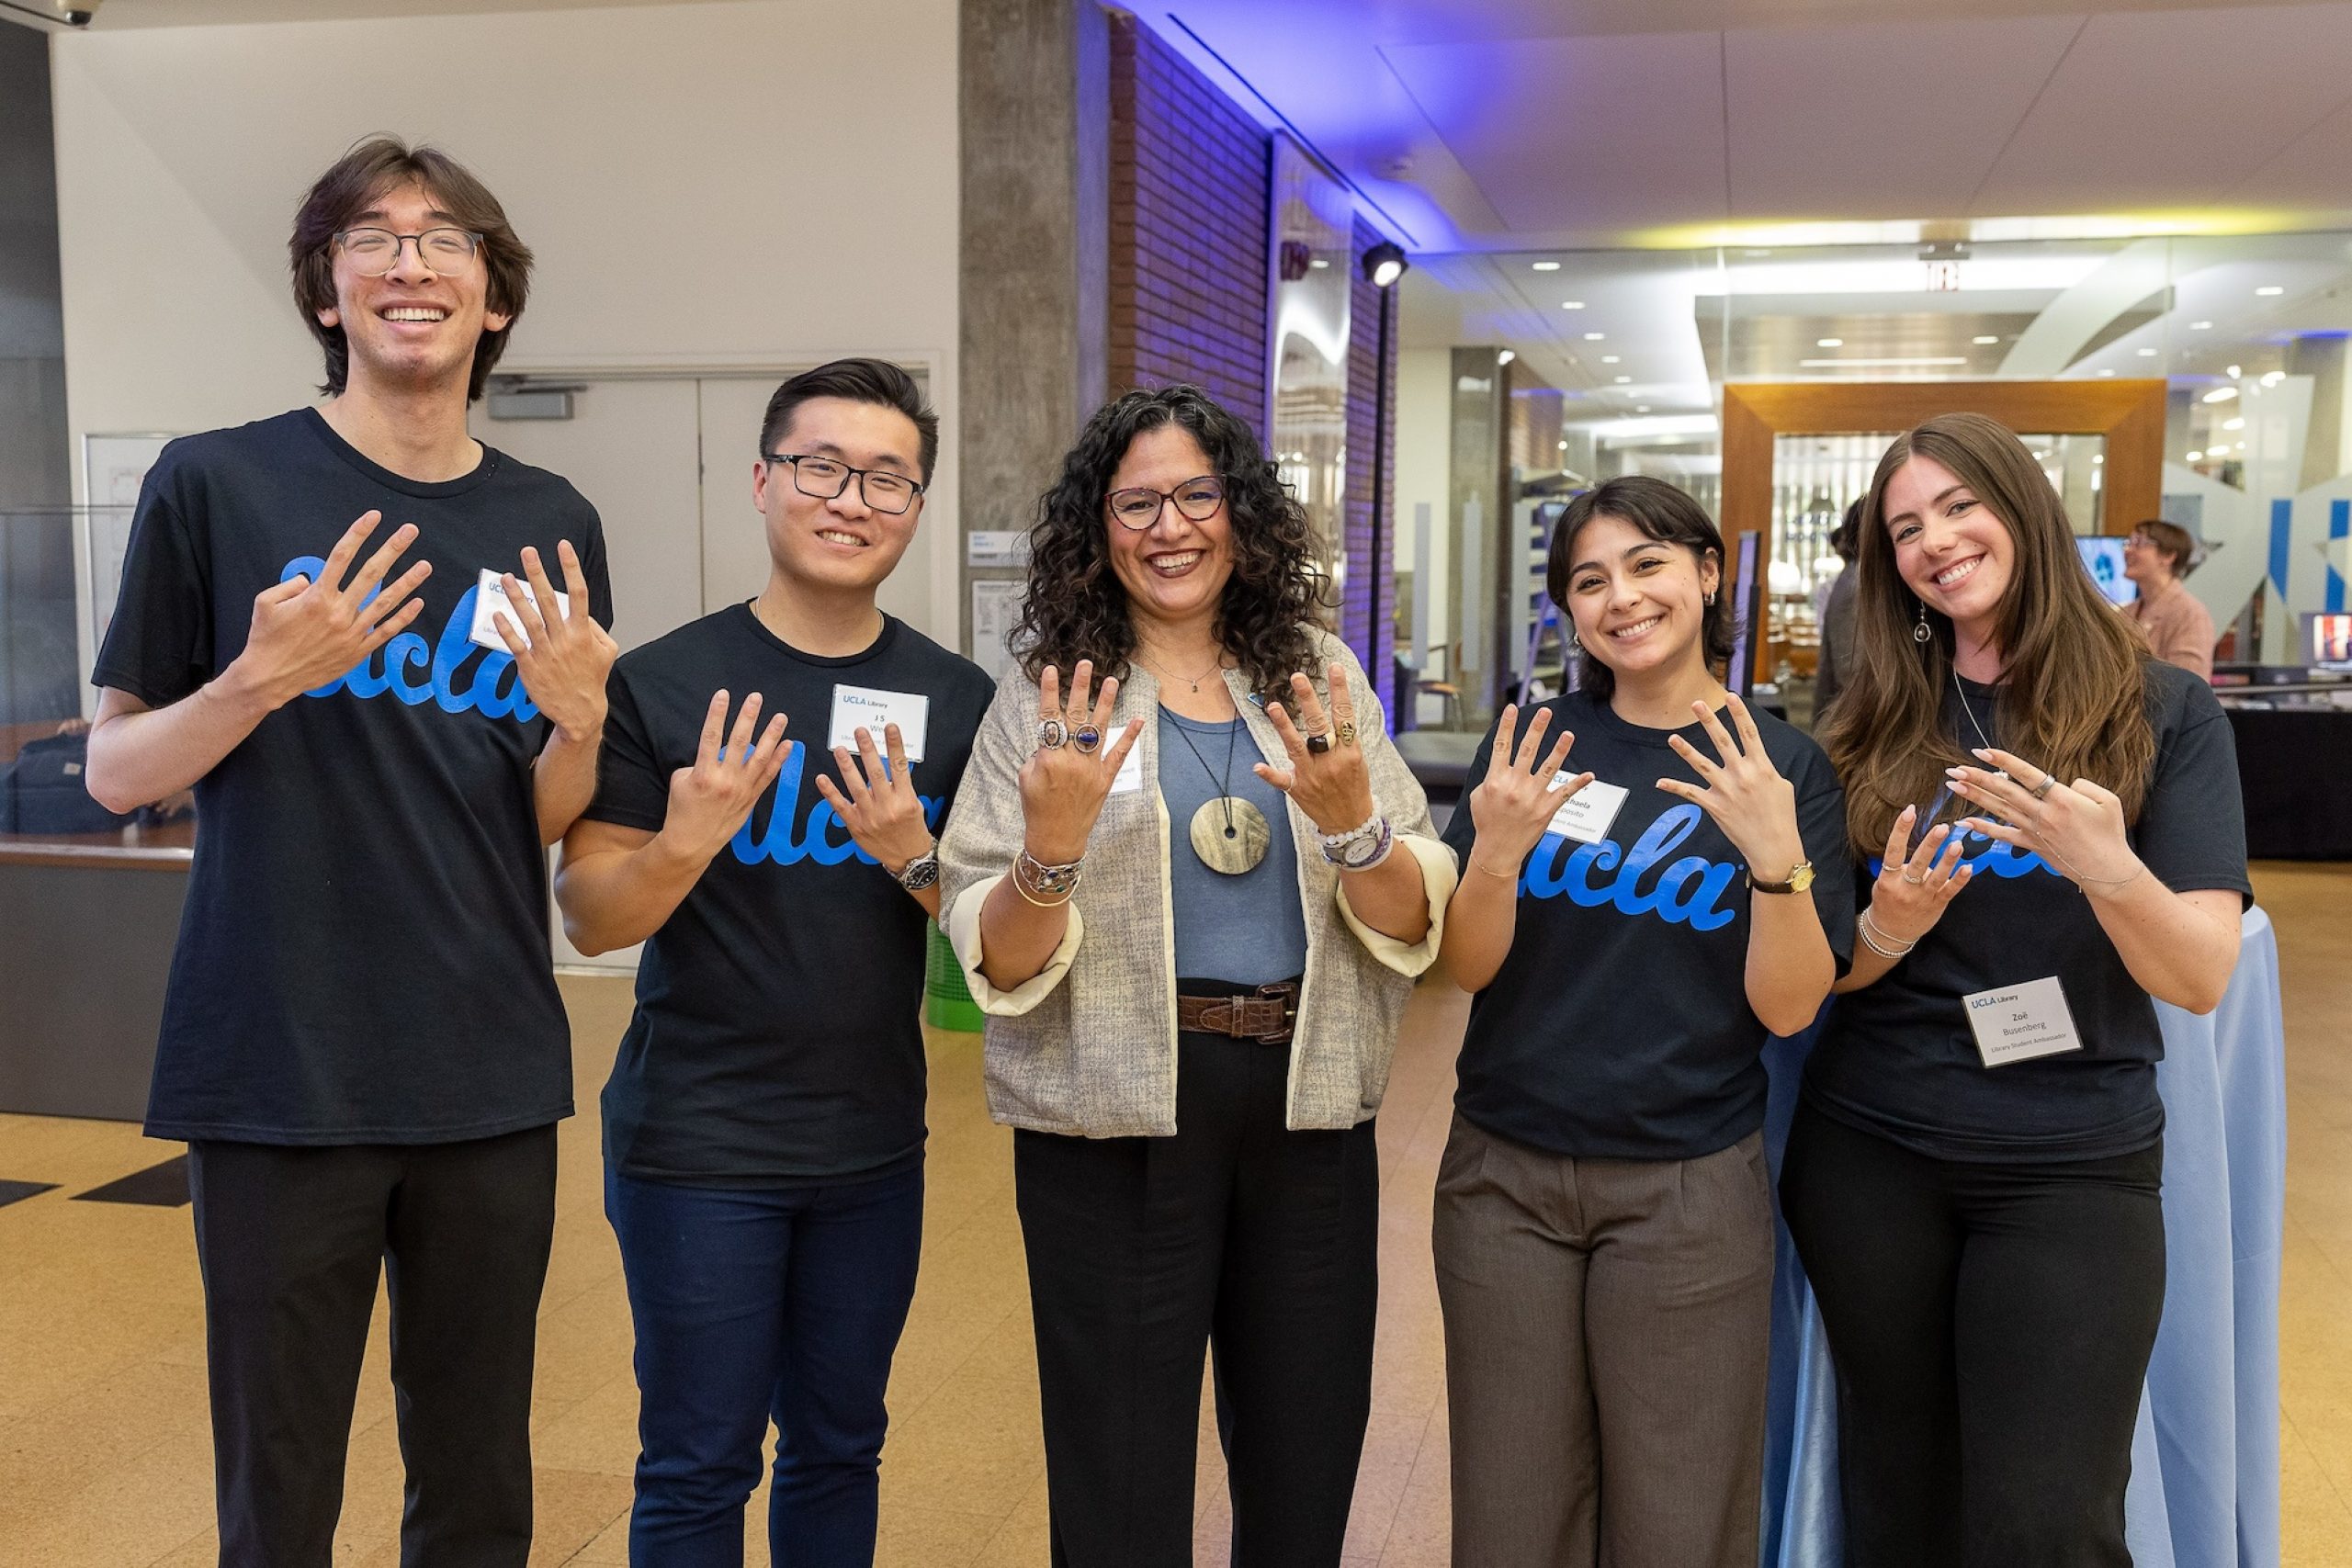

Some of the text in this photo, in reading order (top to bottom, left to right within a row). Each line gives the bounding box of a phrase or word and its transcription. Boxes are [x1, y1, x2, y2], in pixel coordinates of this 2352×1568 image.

[842, 694, 888, 709] UCLA Library
[1566, 798, 1590, 809] haela
[1559, 808, 1584, 818] posito
[1972, 994, 2018, 1009] UCLA Library
[2012, 1011, 2029, 1021] Zoë
[2003, 1021, 2047, 1036] Busenberg
[1991, 1032, 2066, 1053] Library Student Ambassador
